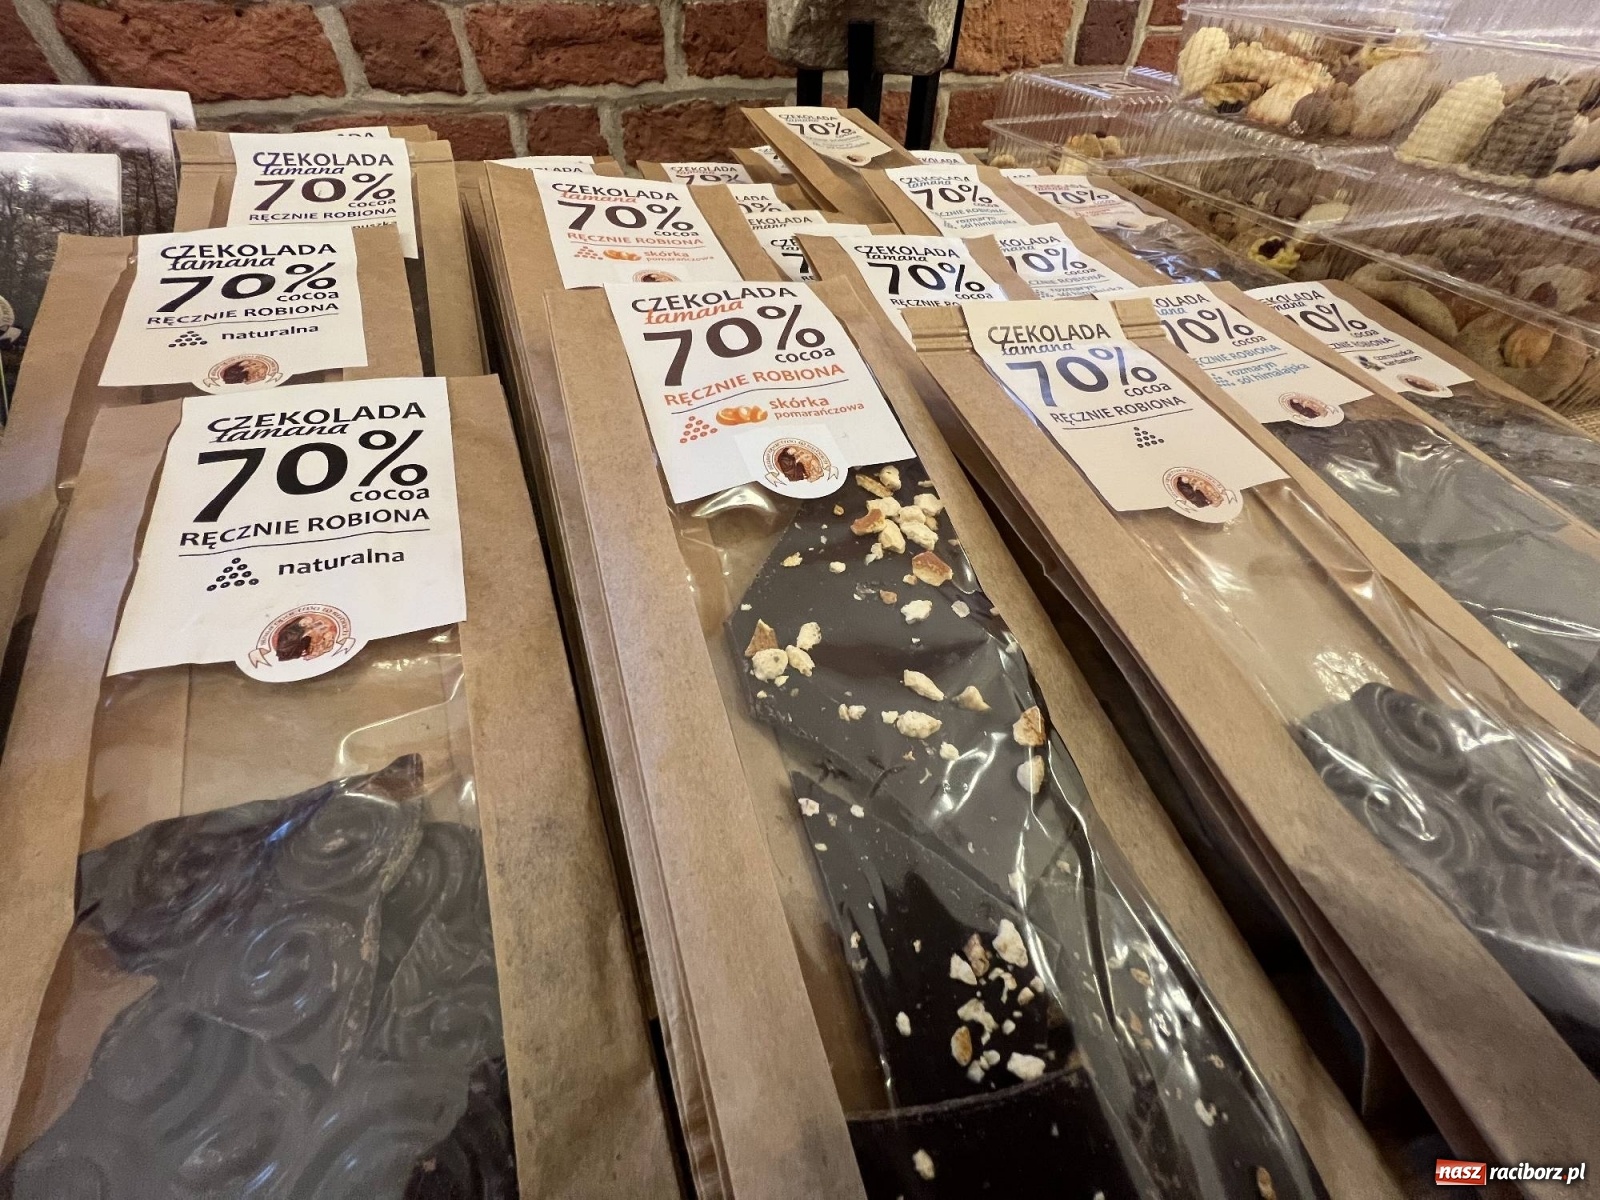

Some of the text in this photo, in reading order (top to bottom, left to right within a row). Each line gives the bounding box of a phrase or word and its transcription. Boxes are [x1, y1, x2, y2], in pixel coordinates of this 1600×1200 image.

[787, 122, 852, 135] 70%
[253, 151, 394, 168] CZEKOLADA
[260, 163, 345, 176] łamana
[676, 174, 740, 185] 70%
[253, 173, 396, 211] 70%
[551, 182, 679, 201] CZEKOLADA
[560, 190, 637, 204] łamana
[910, 184, 993, 210] 70%
[1038, 189, 1110, 205] 70%
[348, 199, 396, 208] cocoa
[249, 207, 397, 223] RĘCZNIE ROBIONA
[557, 200, 694, 231] 70%
[748, 217, 813, 226] EKOLADA
[567, 231, 704, 245] RĘCZNIE ROBIONA
[999, 235, 1061, 247] KOLADA
[160, 243, 337, 259] CZEKOLADA
[644, 250, 690, 258] skórka
[646, 254, 715, 263] pomarańczowa
[854, 245, 961, 259] CZEKOLADA
[866, 252, 928, 262] łamana
[168, 256, 276, 271] łamana
[868, 262, 986, 295] 70%
[1057, 273, 1106, 284] ROBIONA
[1064, 268, 1098, 276] cocoa
[156, 262, 337, 313] 70%
[277, 291, 339, 302] cocoa
[631, 287, 798, 313] CZEKOLADA
[955, 292, 994, 300] cocoa
[1155, 293, 1210, 308] OLADA
[147, 303, 339, 326] RĘCZNIE ROBIONA
[644, 298, 744, 325] łamana
[1284, 303, 1368, 332] 0%
[221, 325, 320, 340] naturalna
[988, 323, 1112, 345] CZEKOLADA
[643, 304, 826, 387] 70%
[1002, 341, 1075, 356] łamana
[1232, 335, 1268, 347] cocoa
[775, 347, 836, 363] cocoa
[1232, 344, 1281, 360] ROBIONA
[1006, 346, 1158, 407] 70%
[1227, 361, 1278, 377] rozmaryn
[1237, 363, 1310, 385] sól himalajska
[664, 363, 846, 407] RĘCZNIE ROBIONA
[1124, 382, 1172, 397] cocoa
[769, 395, 830, 410] skórka
[774, 400, 865, 421] pomarańczowa
[207, 401, 427, 434] CZEKOLADA
[1050, 395, 1186, 427] RĘCZNIE ROBIONA
[209, 422, 350, 443] łamana
[193, 429, 428, 523] 70%
[350, 487, 430, 502] cocoa
[179, 507, 430, 550] RĘCZNIE ROBIONA
[278, 548, 406, 575] naturalna
